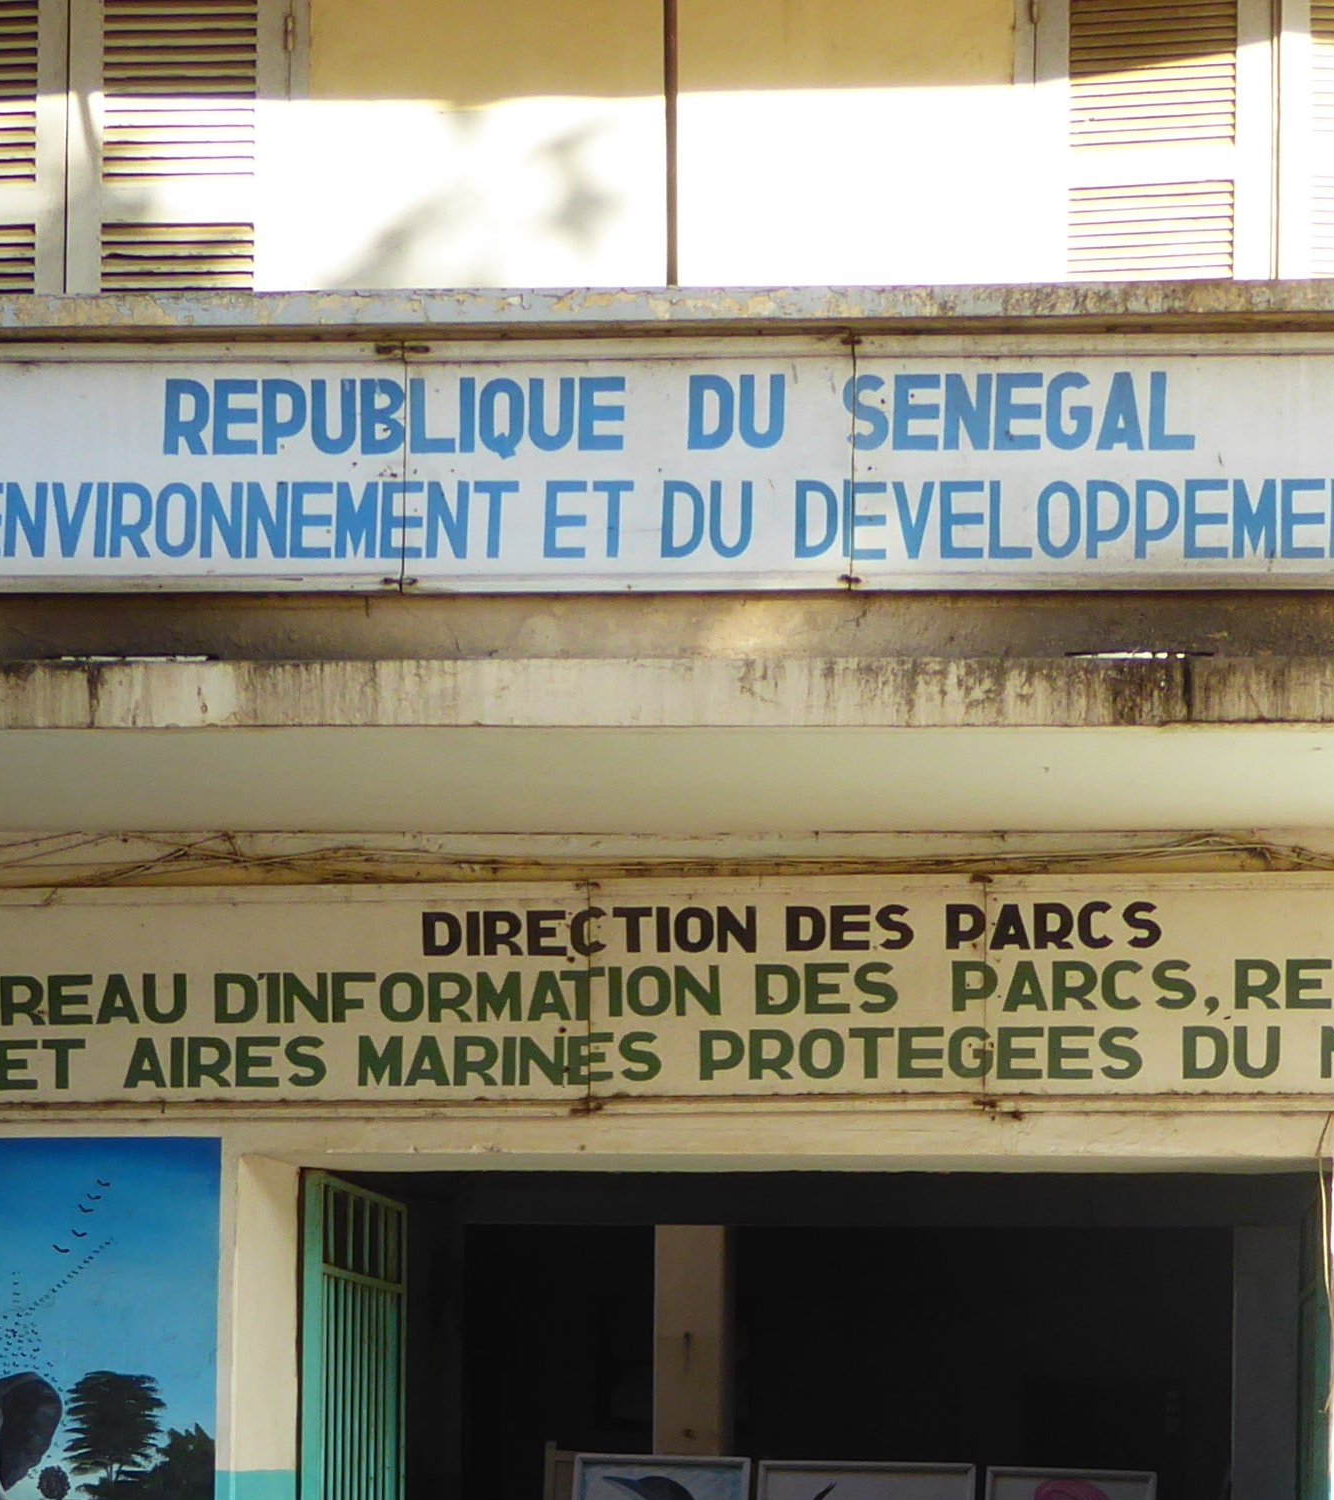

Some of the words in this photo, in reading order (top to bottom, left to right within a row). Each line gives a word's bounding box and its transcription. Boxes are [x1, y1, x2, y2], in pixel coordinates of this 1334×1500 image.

[163, 376, 626, 459] REPUBLIQUE
[688, 374, 786, 450] DU
[843, 372, 1195, 451] SENEGAL
[543, 479, 635, 559] ET
[661, 479, 754, 559] DU
[422, 905, 757, 956] DIRECTION
[785, 903, 913, 952] DES
[945, 900, 1162, 950] PARCS
[214, 965, 721, 1024] D'INFORMATION
[755, 961, 898, 1015] DES
[123, 1036, 327, 1089] AIRES
[357, 1031, 662, 1087] MARINES
[699, 1026, 1143, 1082] PROTEGEES
[1182, 1026, 1281, 1079] DU
